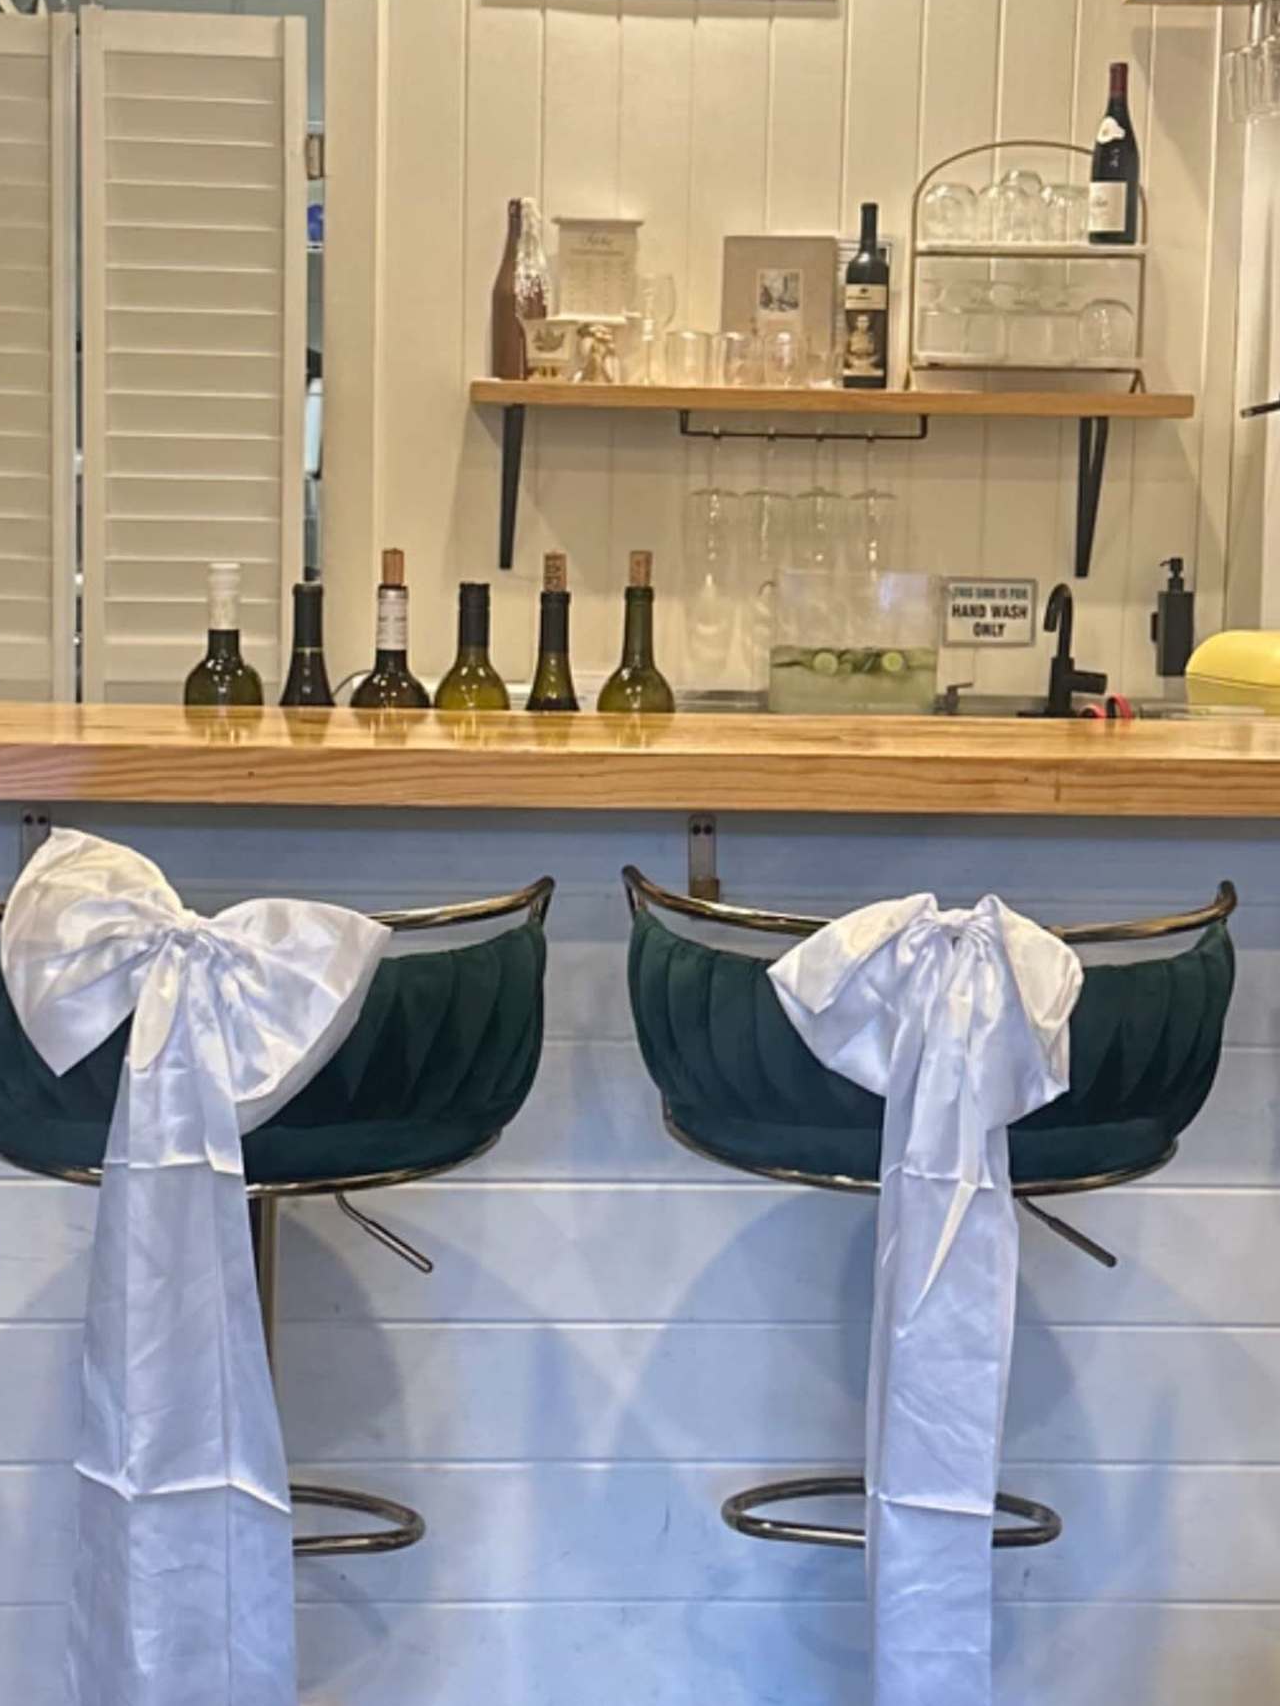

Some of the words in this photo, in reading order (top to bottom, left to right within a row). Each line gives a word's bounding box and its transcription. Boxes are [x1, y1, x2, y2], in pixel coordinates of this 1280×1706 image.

[951, 603, 987, 619] HAND
[990, 603, 1028, 620] WASH
[972, 620, 1006, 638] ONLY
